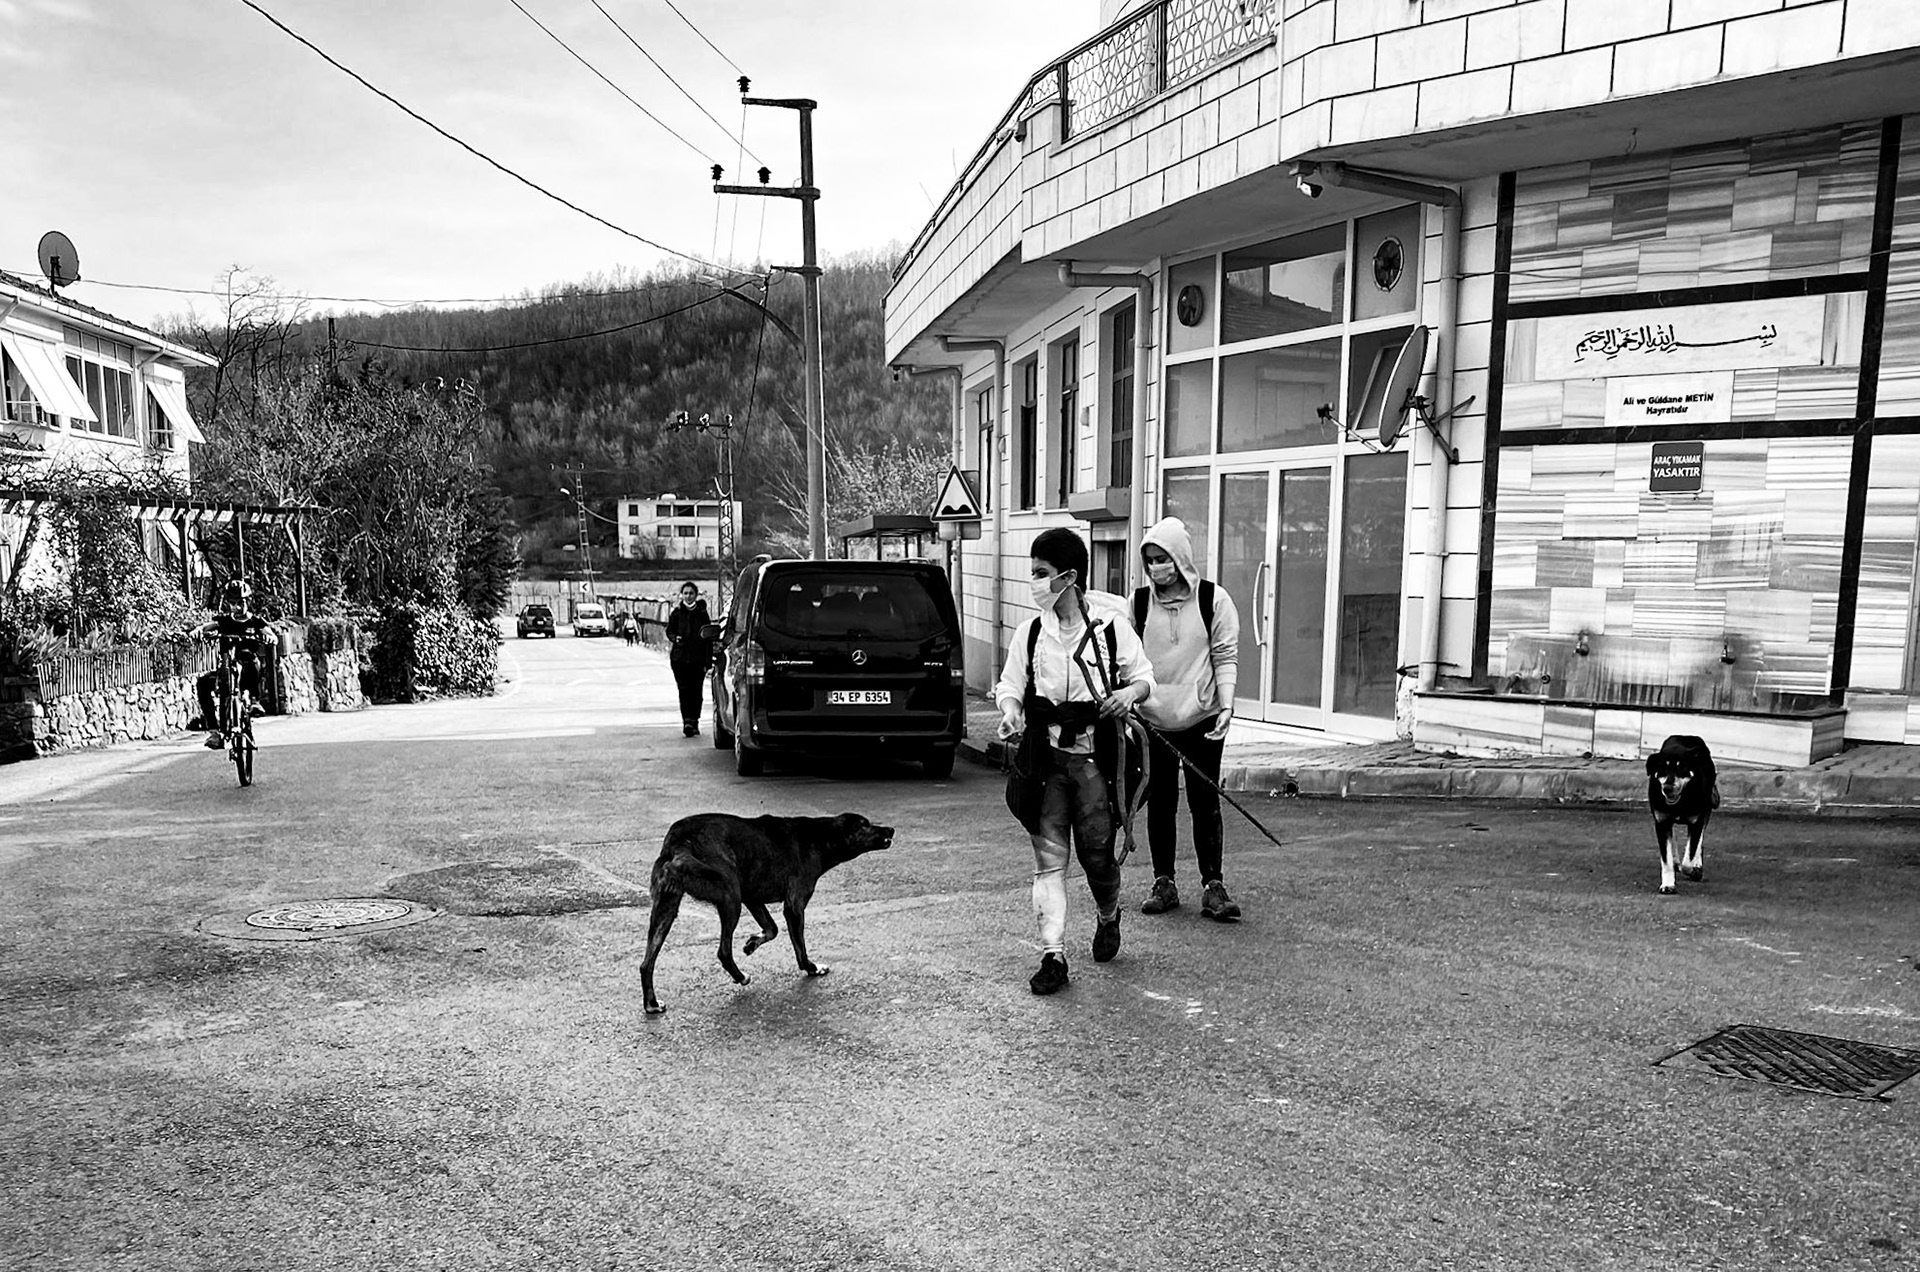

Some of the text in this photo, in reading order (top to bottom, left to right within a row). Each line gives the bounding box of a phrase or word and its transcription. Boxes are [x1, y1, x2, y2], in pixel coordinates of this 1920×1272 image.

[1623, 397, 1634, 406] Ali
[1685, 392, 1714, 403] METİN
[1653, 454, 1701, 466] ARAÇ YIKAMAK
[1653, 466, 1700, 478] YASAKTIR
[833, 691, 889, 703] 34 EP 6354
